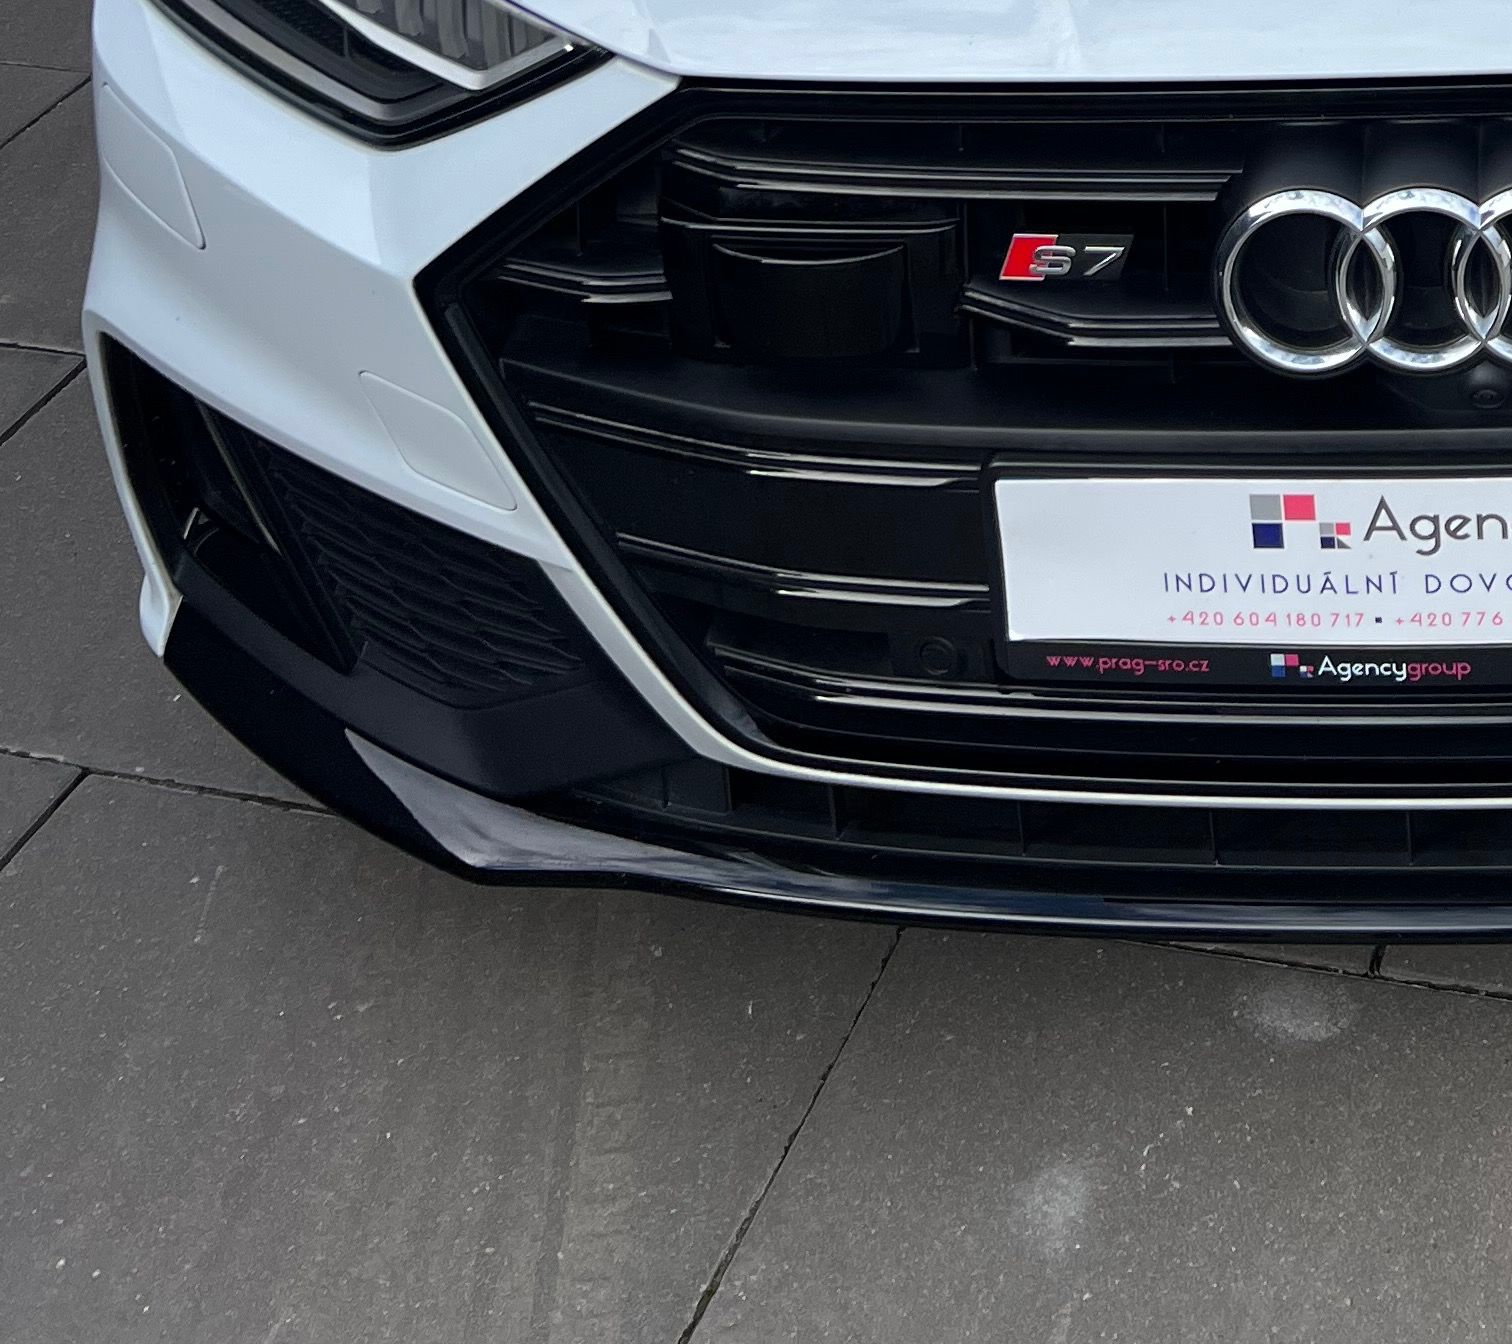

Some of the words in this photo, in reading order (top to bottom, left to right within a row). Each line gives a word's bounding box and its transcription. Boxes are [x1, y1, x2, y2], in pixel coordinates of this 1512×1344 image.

[1029, 245, 1125, 276] S7
[1163, 570, 1399, 595] INDIVIDUÁLNÍ
[1168, 610, 1225, 626] +420
[1329, 612, 1365, 628] 717
[1395, 610, 1453, 627] +420
[1461, 610, 1504, 627] 776
[1046, 654, 1210, 676] www.prag-sro.cz
[1318, 655, 1472, 682] Agencygroup
